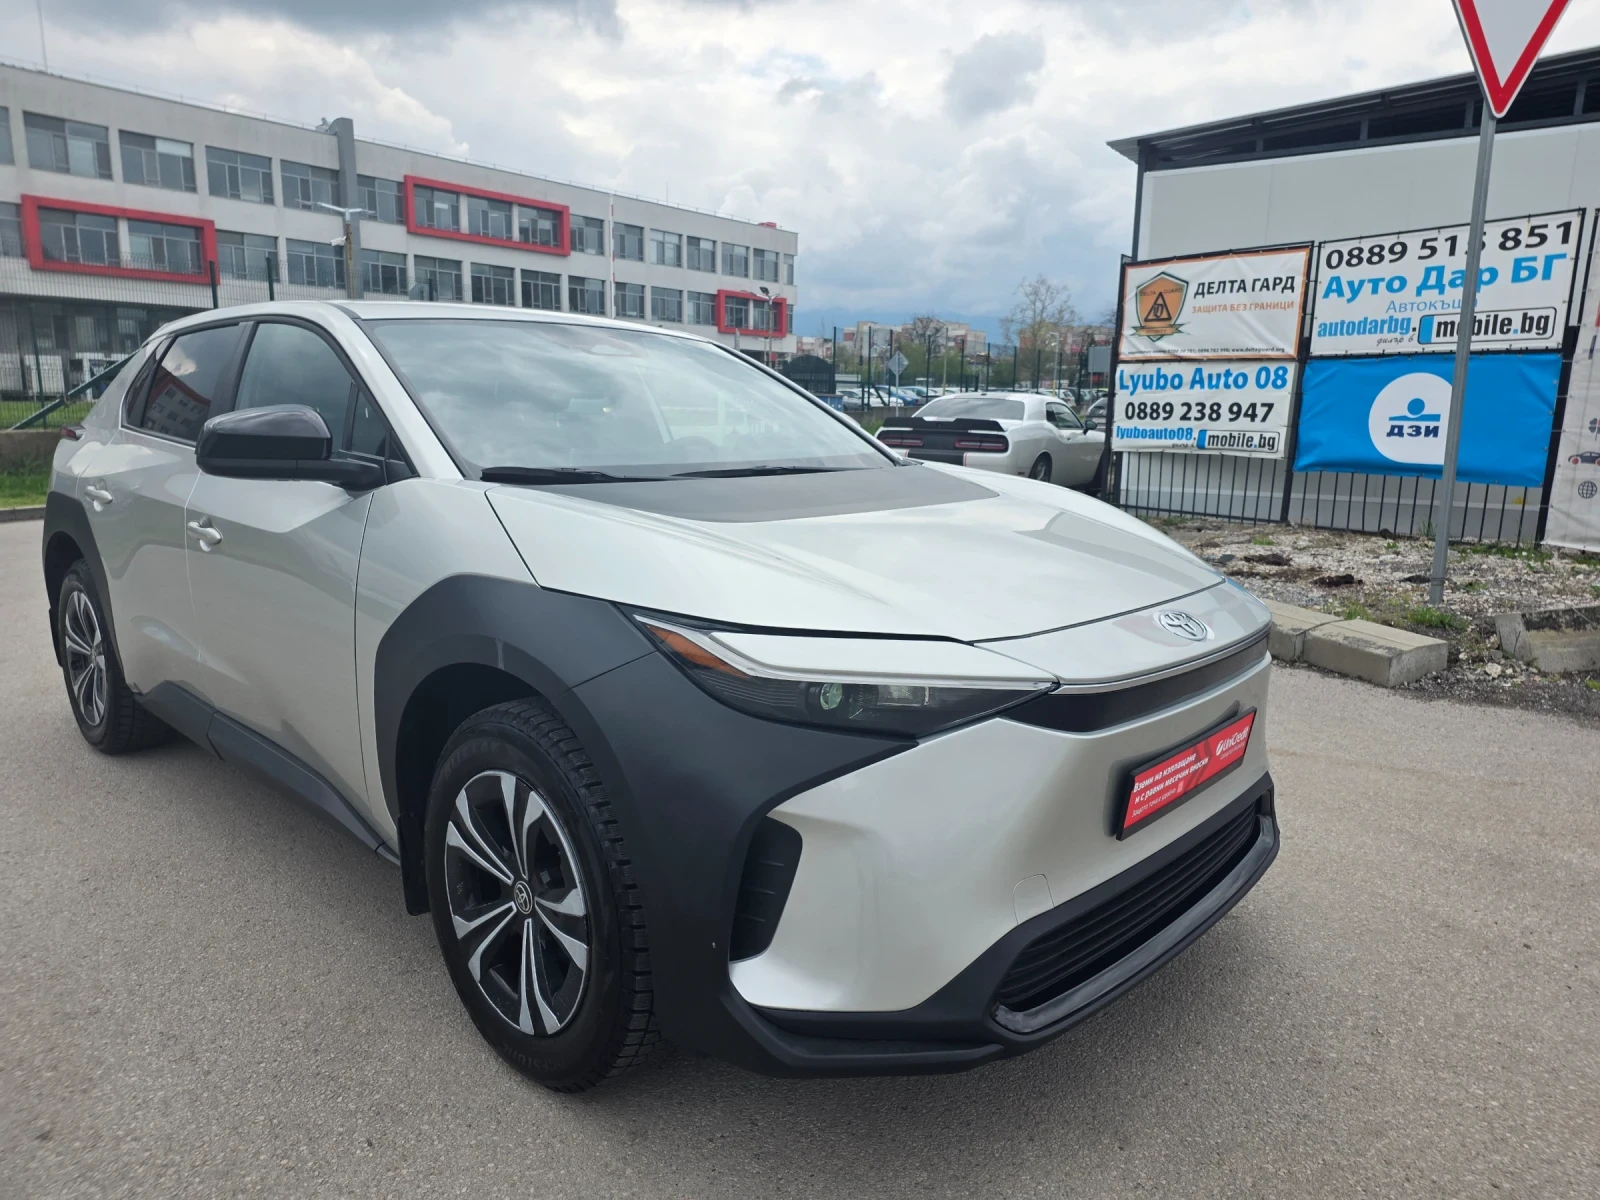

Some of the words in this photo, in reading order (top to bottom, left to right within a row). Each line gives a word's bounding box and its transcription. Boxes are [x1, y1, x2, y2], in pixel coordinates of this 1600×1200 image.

[1326, 242, 1408, 270] 0889
[1498, 221, 1572, 250] 851
[1194, 279, 1247, 299] ДЕЛТА
[1251, 276, 1296, 294] ГАРД
[1322, 274, 1408, 304] Ауто
[1416, 265, 1498, 297] Дар
[1510, 253, 1568, 284] БГ
[1192, 304, 1228, 314] ЗАЩИТА
[1230, 302, 1247, 312] БЕЗ
[1249, 300, 1294, 312] ГРАНИЦИ
[1119, 368, 1183, 396] Lyubo
[1189, 367, 1248, 390] Auto
[1255, 366, 1288, 390] 08
[1125, 402, 1174, 420] 0889
[1180, 402, 1222, 422] 238
[1228, 402, 1274, 422] 947
[1207, 433, 1276, 450] mobile.bg
[1386, 424, 1440, 438] ДЗИ
[1134, 776, 1154, 792] Вземи
[1154, 772, 1162, 782] на
[1162, 753, 1196, 776] изплащане
[1145, 783, 1164, 800] равни
[1164, 768, 1189, 787] месечни
[1190, 757, 1209, 774] вноски
